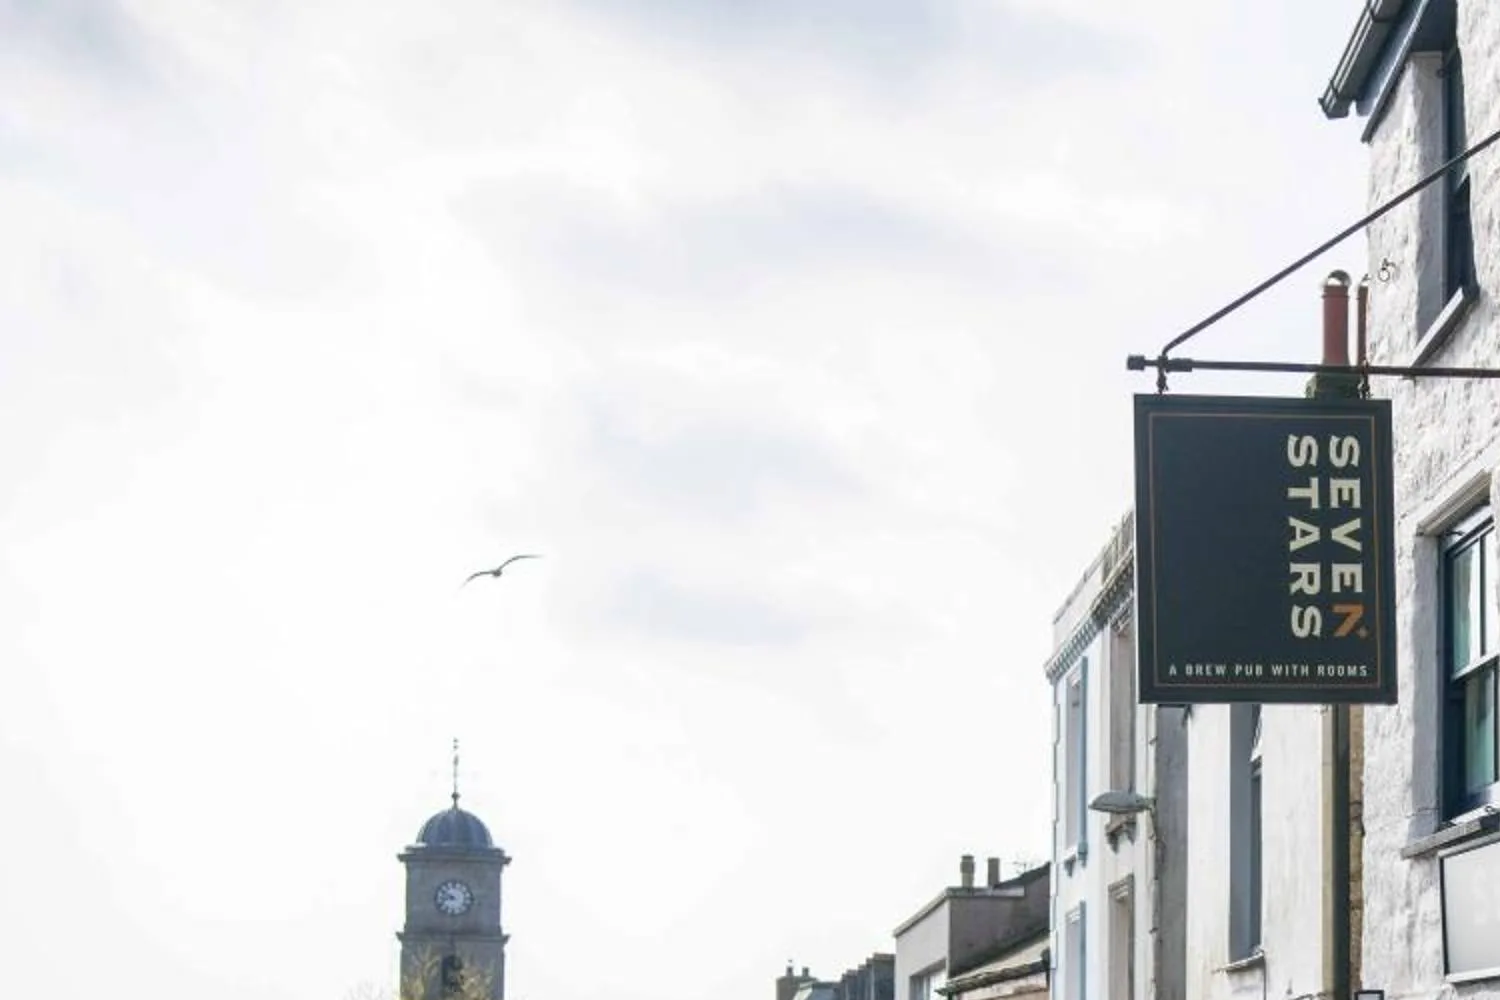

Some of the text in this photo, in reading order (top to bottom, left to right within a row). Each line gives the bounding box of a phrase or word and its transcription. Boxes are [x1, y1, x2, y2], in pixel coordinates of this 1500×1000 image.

[1287, 433, 1322, 638] STARS
[1168, 663, 1368, 678] A BREW PUB WITH ROOMS
